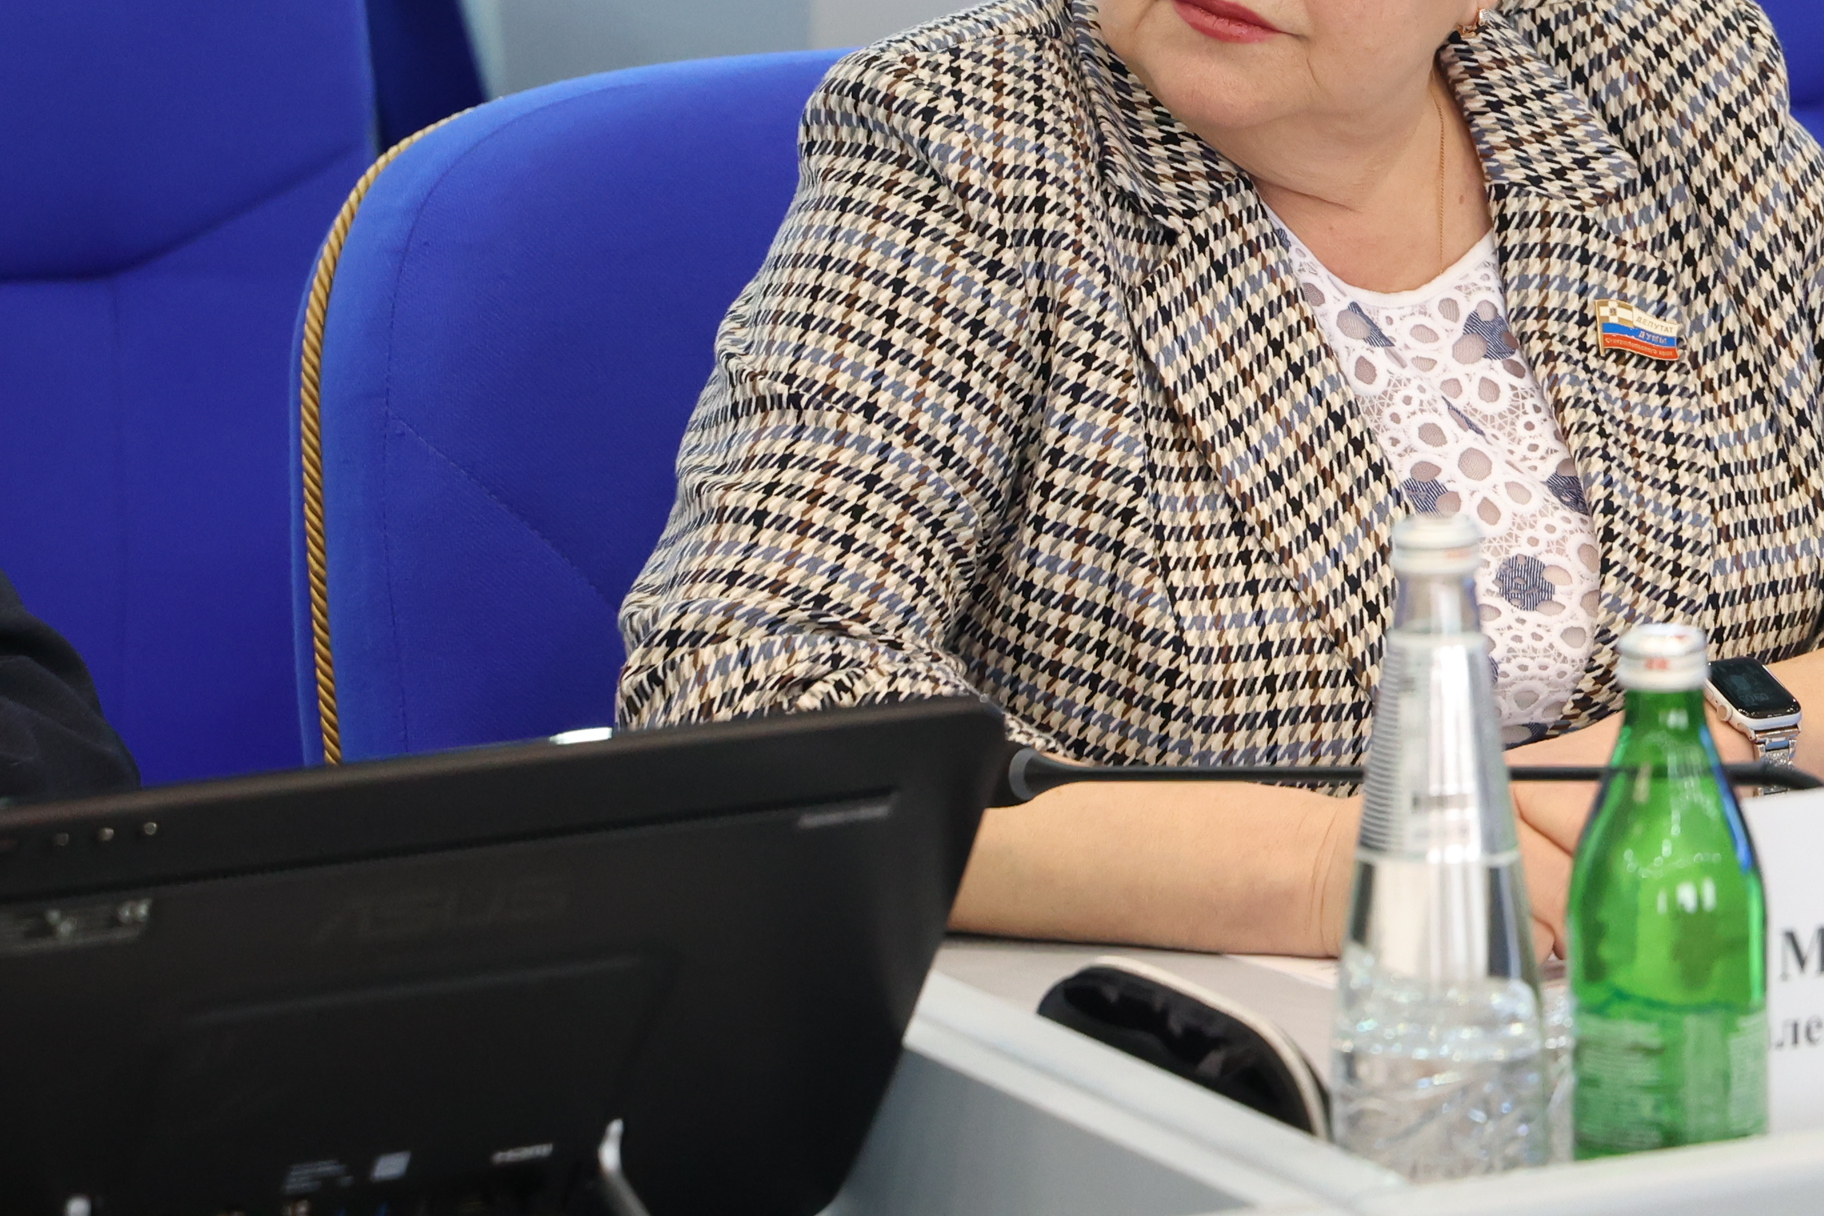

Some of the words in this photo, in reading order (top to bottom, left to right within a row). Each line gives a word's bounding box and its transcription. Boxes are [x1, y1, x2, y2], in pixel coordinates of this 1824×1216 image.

[1636, 317, 1673, 332] ДЕПУТАТ
[1639, 331, 1667, 344] ДУМЫ
[310, 874, 572, 946] ASUS
